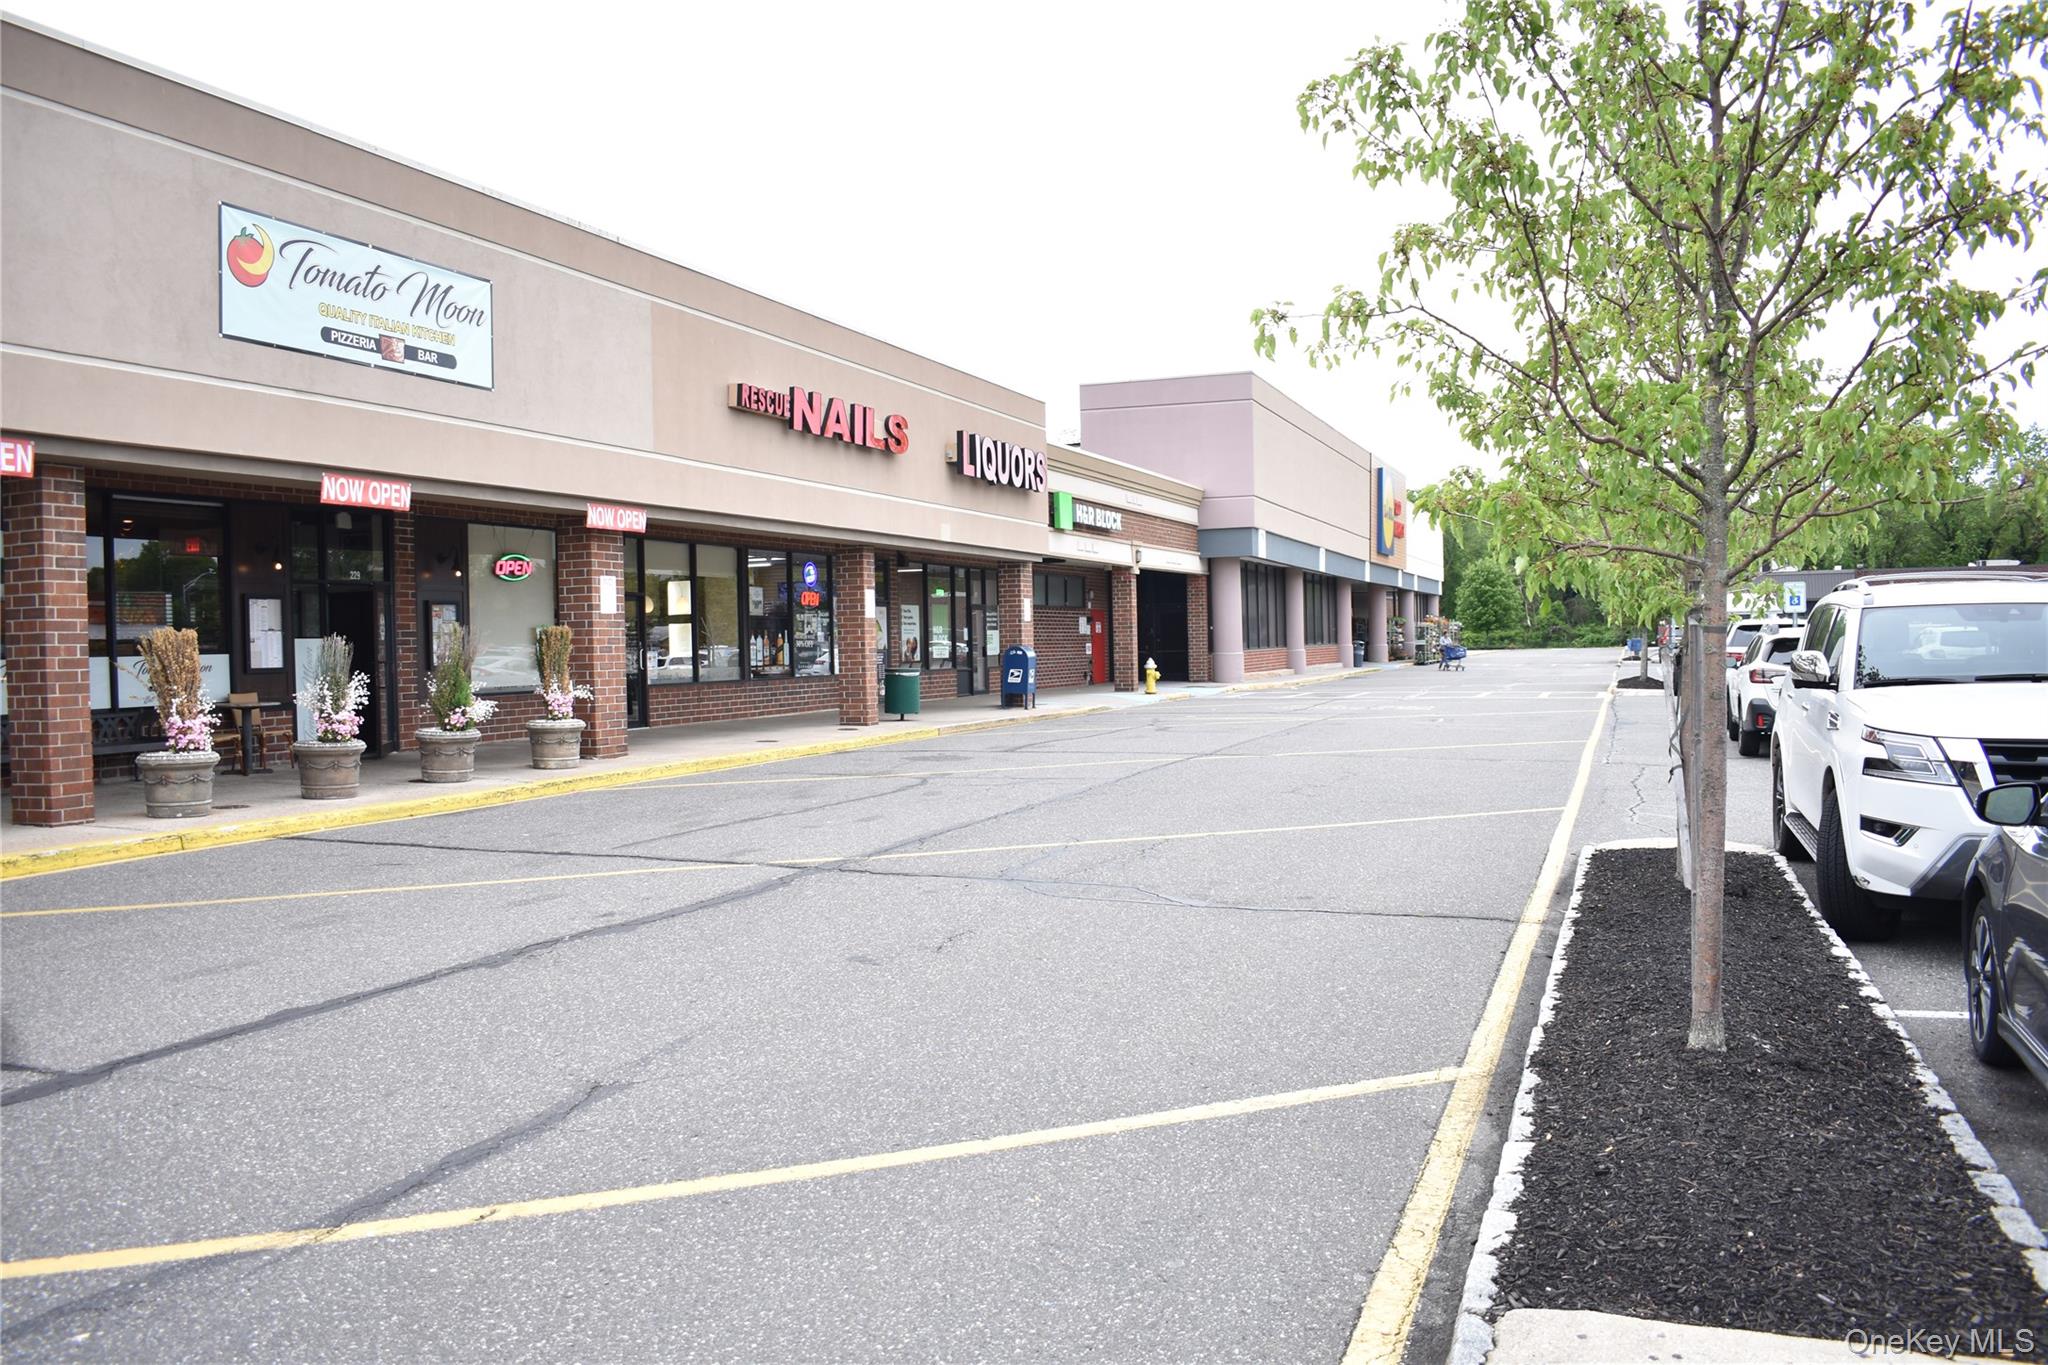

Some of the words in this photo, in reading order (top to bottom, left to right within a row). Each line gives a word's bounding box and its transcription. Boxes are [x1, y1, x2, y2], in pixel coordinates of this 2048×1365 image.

[279, 239, 393, 301] Tomato
[397, 271, 486, 328] Moon
[318, 302, 368, 325] QUALITY
[368, 313, 410, 336] ITALIAN
[411, 323, 456, 346] KITCHEN
[331, 330, 377, 351] PIZZERIA
[418, 350, 438, 364] BAR
[740, 383, 790, 418] RESCUE
[791, 386, 910, 454] NAILS
[959, 430, 1048, 492] LIQUORS
[323, 476, 365, 503] NOW
[368, 481, 411, 508] OPEN
[588, 506, 615, 528] NOW
[617, 509, 647, 533] OPEN
[1076, 503, 1094, 526] H&R
[1096, 508, 1122, 531] BLOCK
[350, 571, 361, 580] 229
[495, 560, 533, 576] OPEN
